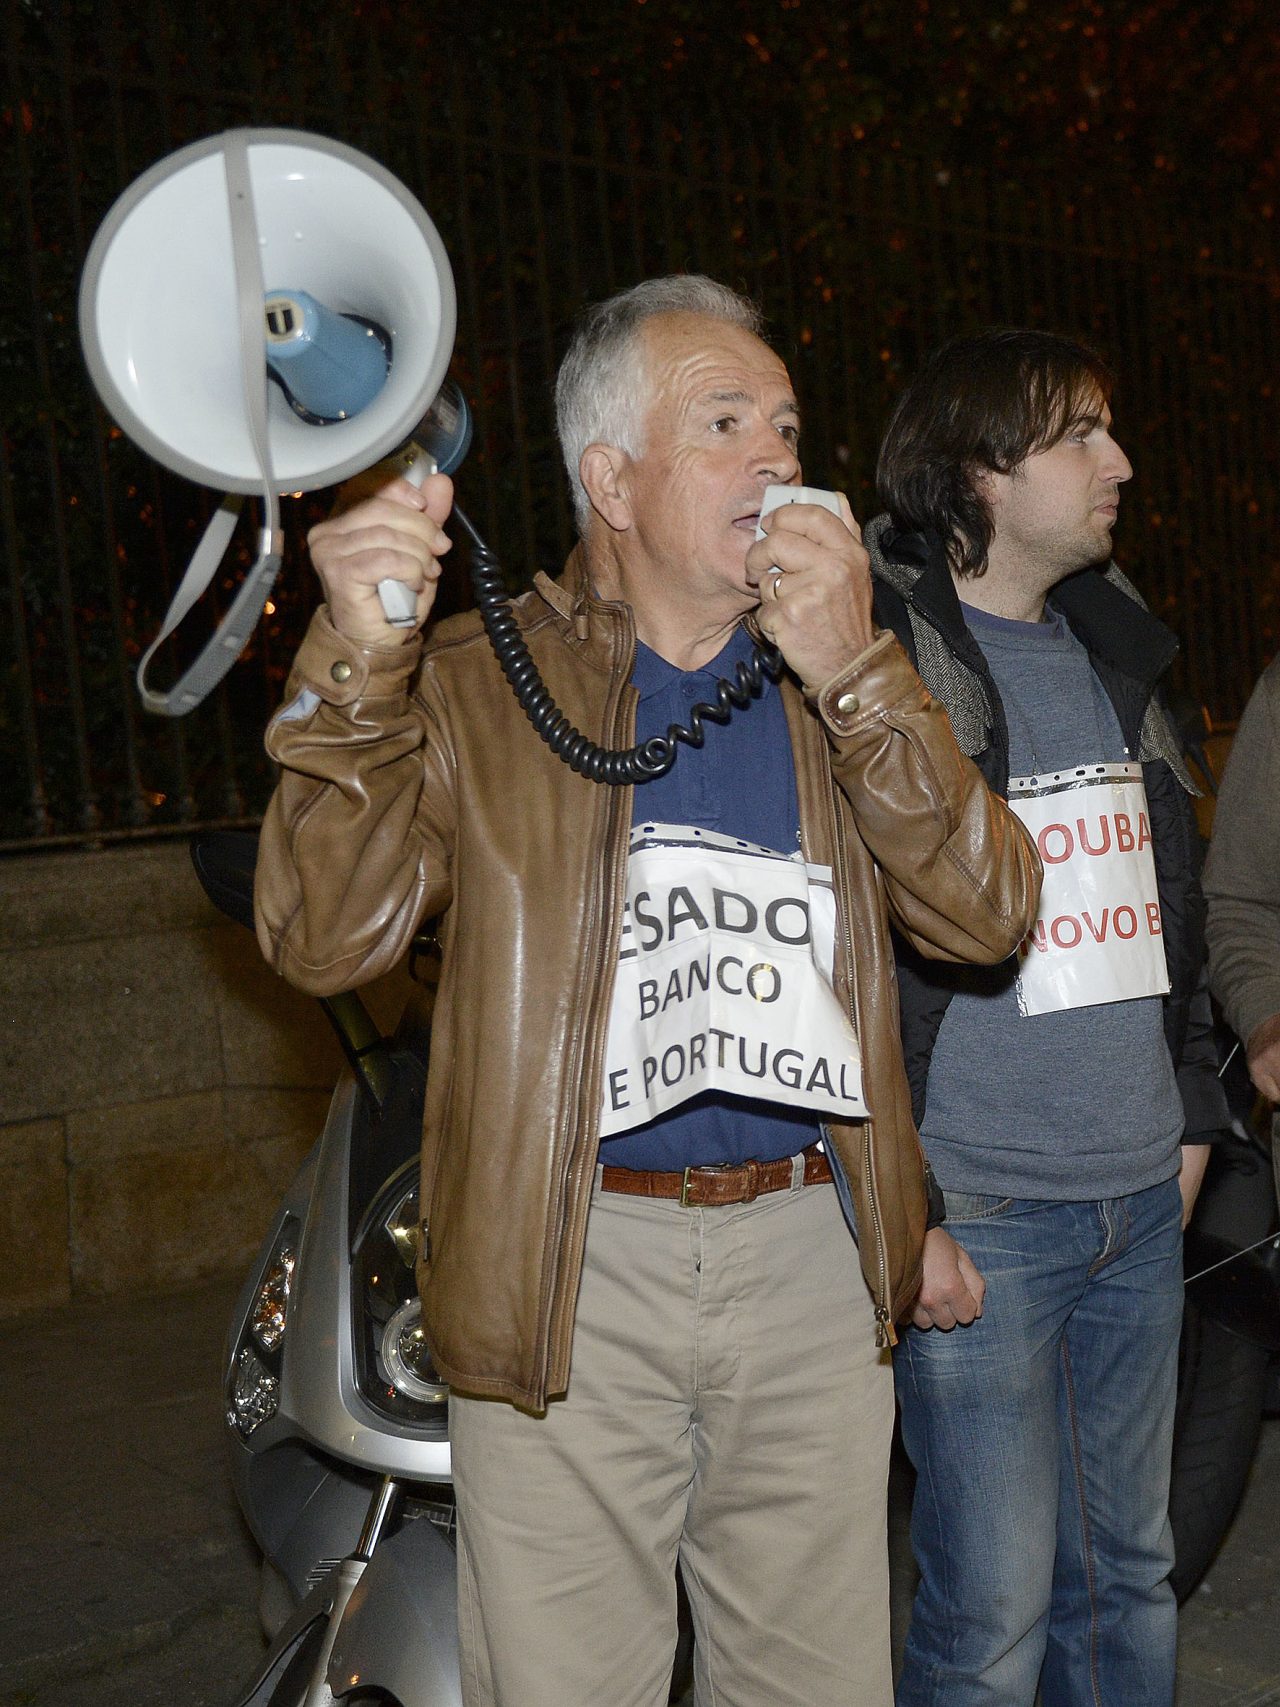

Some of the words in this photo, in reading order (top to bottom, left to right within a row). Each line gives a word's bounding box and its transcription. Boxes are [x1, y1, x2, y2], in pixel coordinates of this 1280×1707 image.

[1020, 905, 1138, 956] NOVO
[638, 954, 782, 1021] BANCO
[642, 1028, 858, 1102] PORTUGAL
